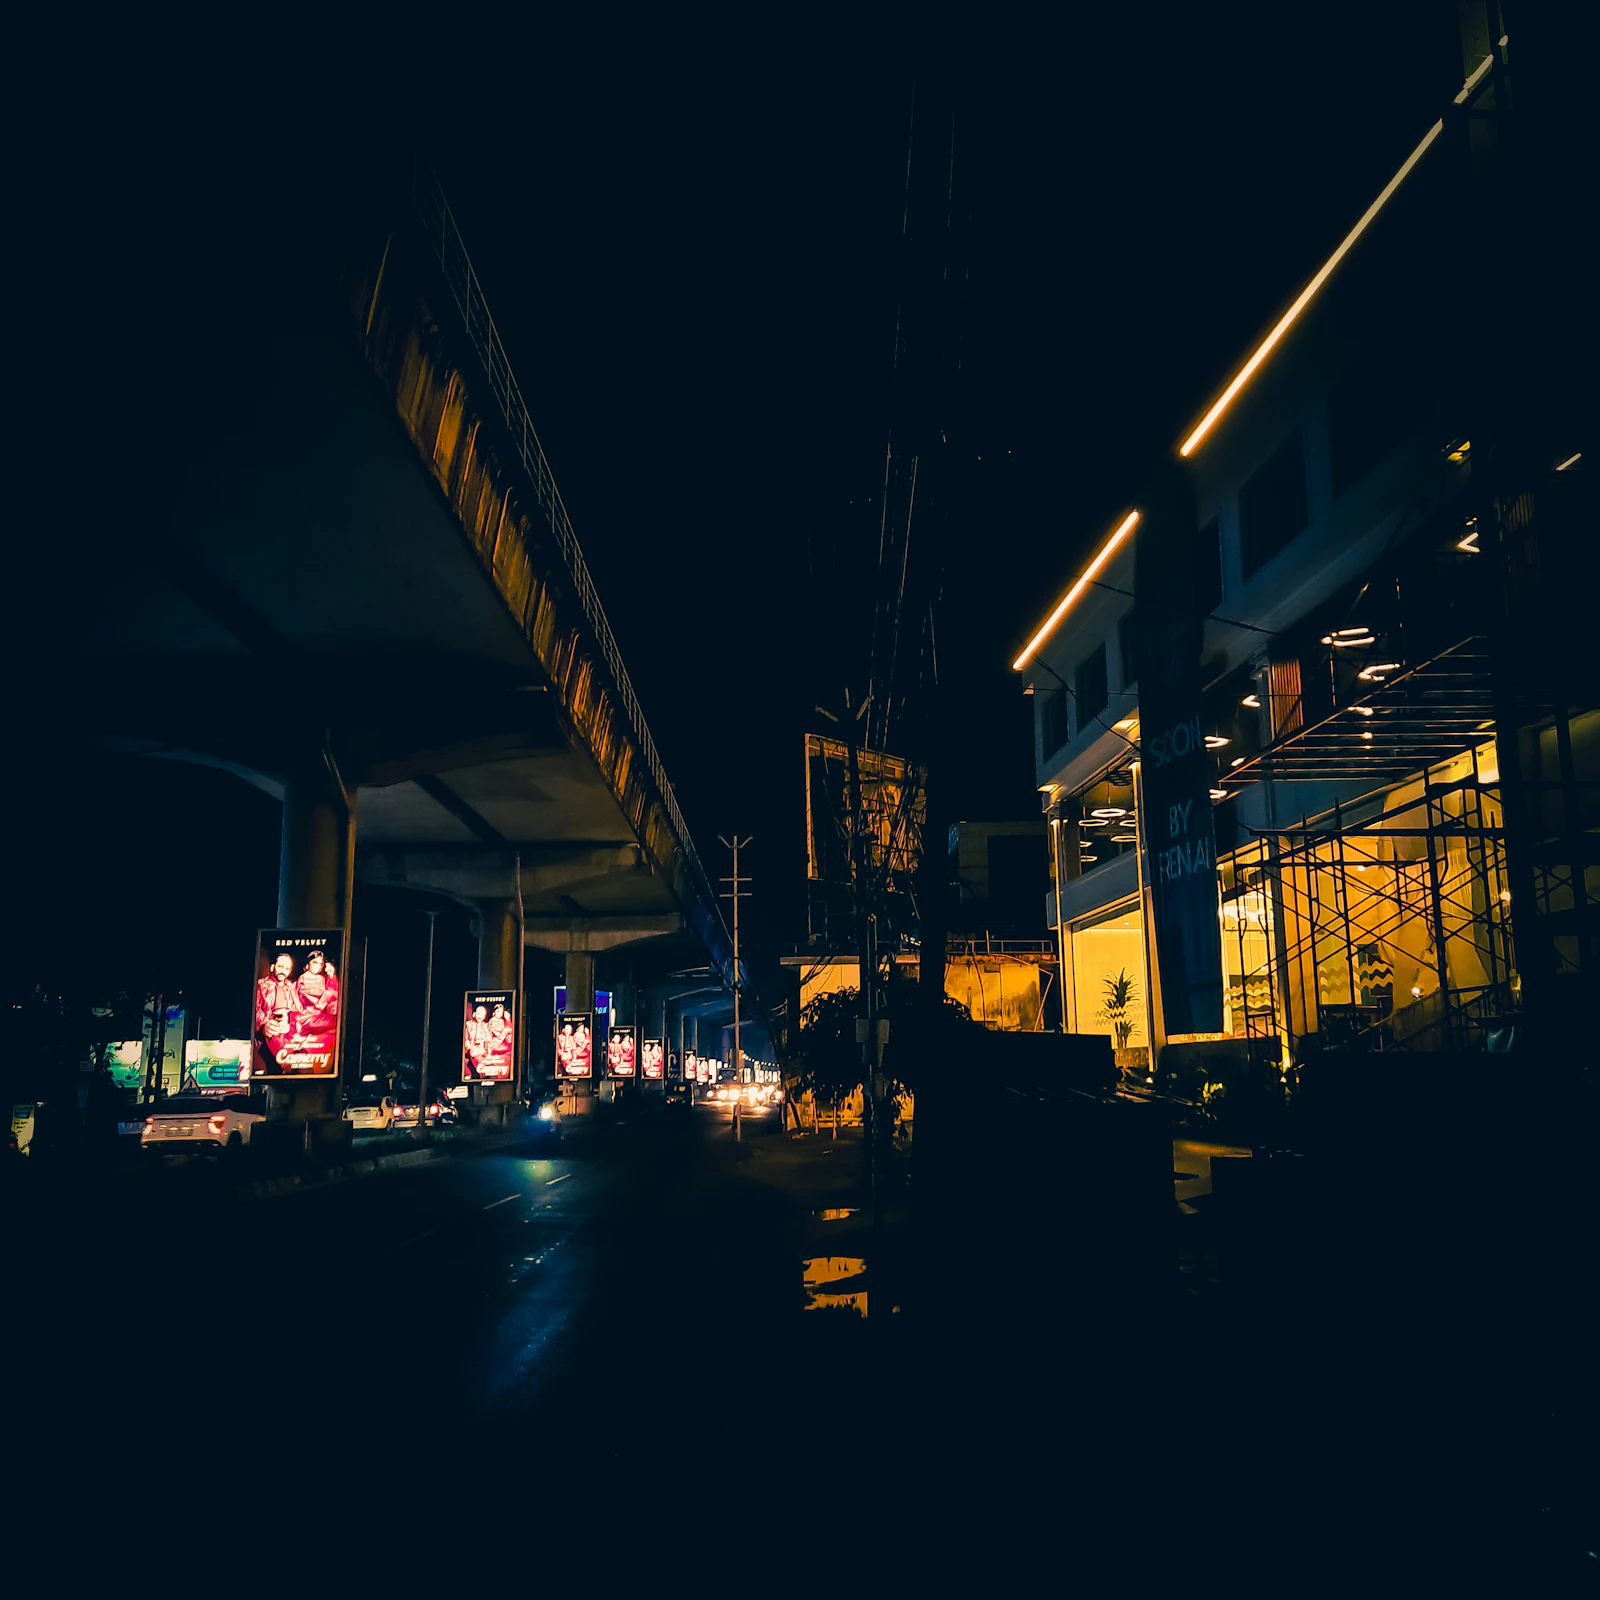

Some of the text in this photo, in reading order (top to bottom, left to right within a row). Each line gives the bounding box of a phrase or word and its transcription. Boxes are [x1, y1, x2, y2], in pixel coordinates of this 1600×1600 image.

[1148, 714, 1201, 768] SOON
[1169, 798, 1193, 839] BY
[1158, 836, 1210, 885] RENAI
[294, 938, 327, 946] VELVET
